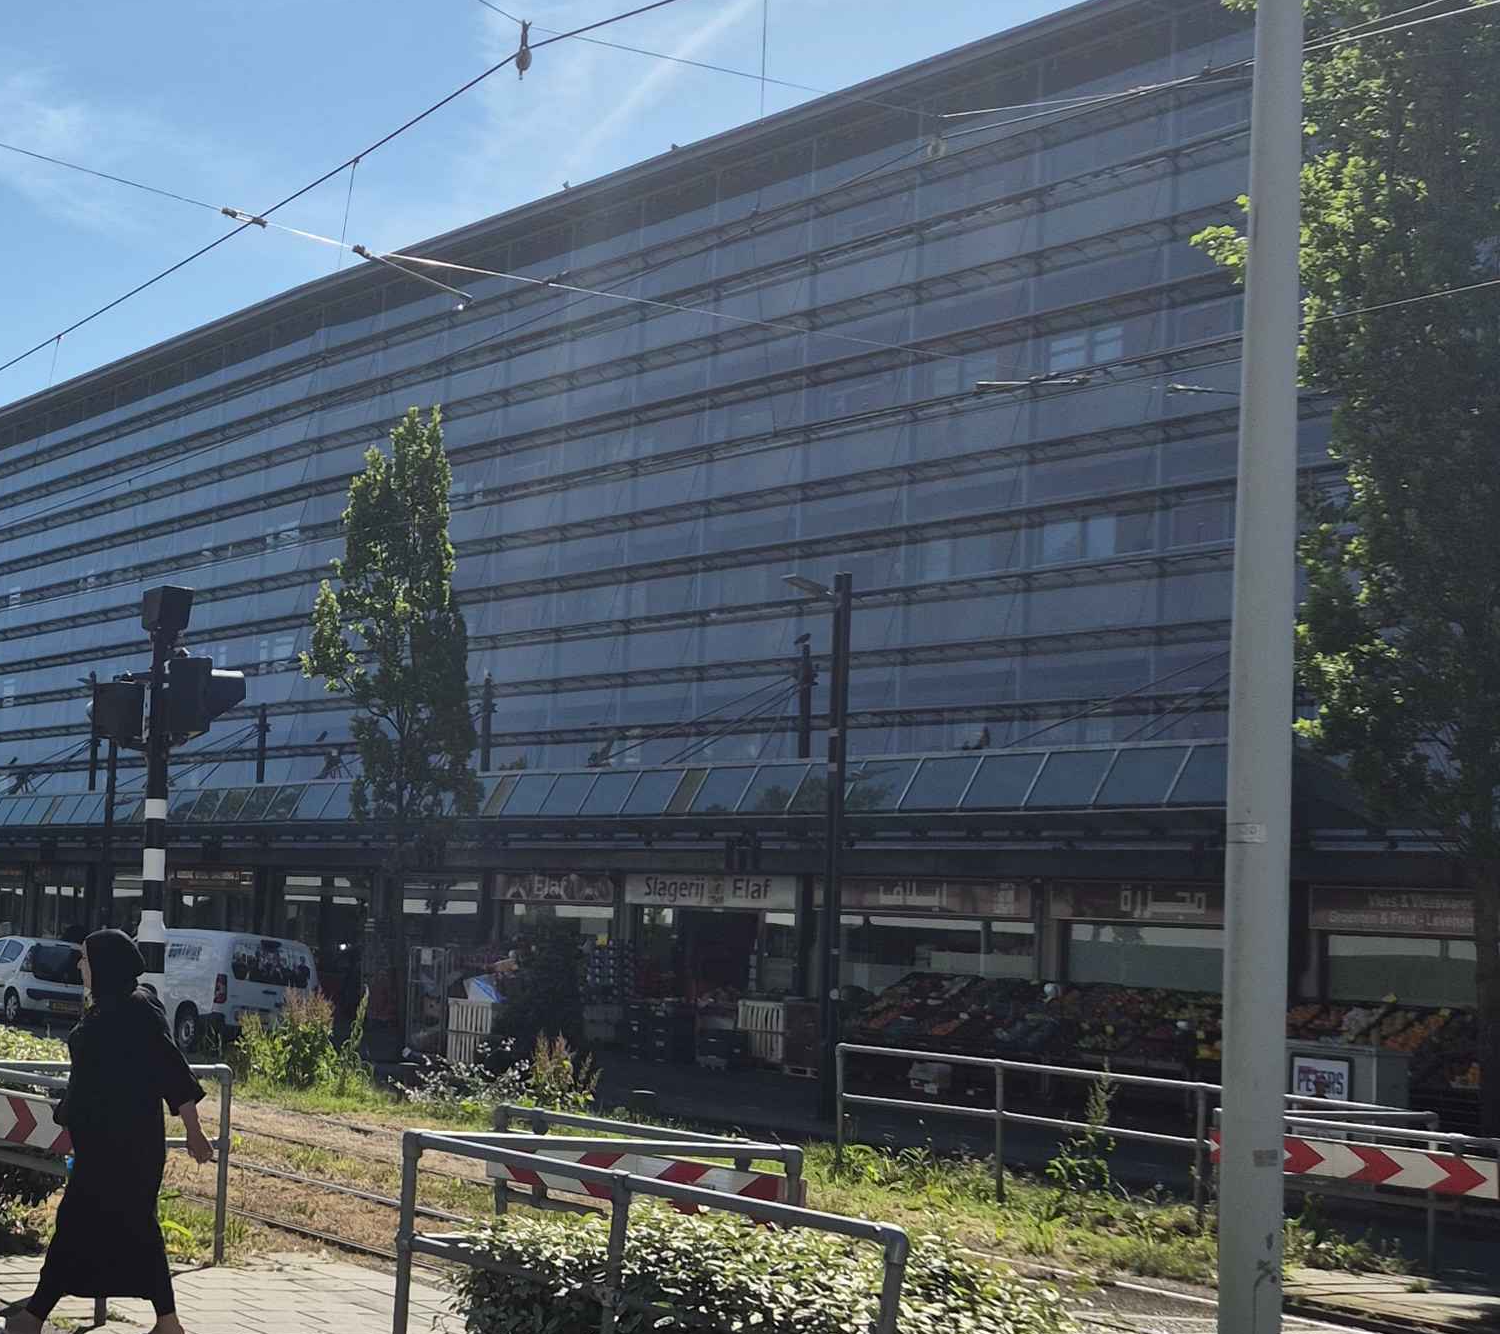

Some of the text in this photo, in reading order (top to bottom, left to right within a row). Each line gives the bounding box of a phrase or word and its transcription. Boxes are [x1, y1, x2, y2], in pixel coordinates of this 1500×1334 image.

[533, 875, 567, 895] Elaf
[644, 876, 705, 902] Slagerij
[732, 878, 772, 899] Elaf
